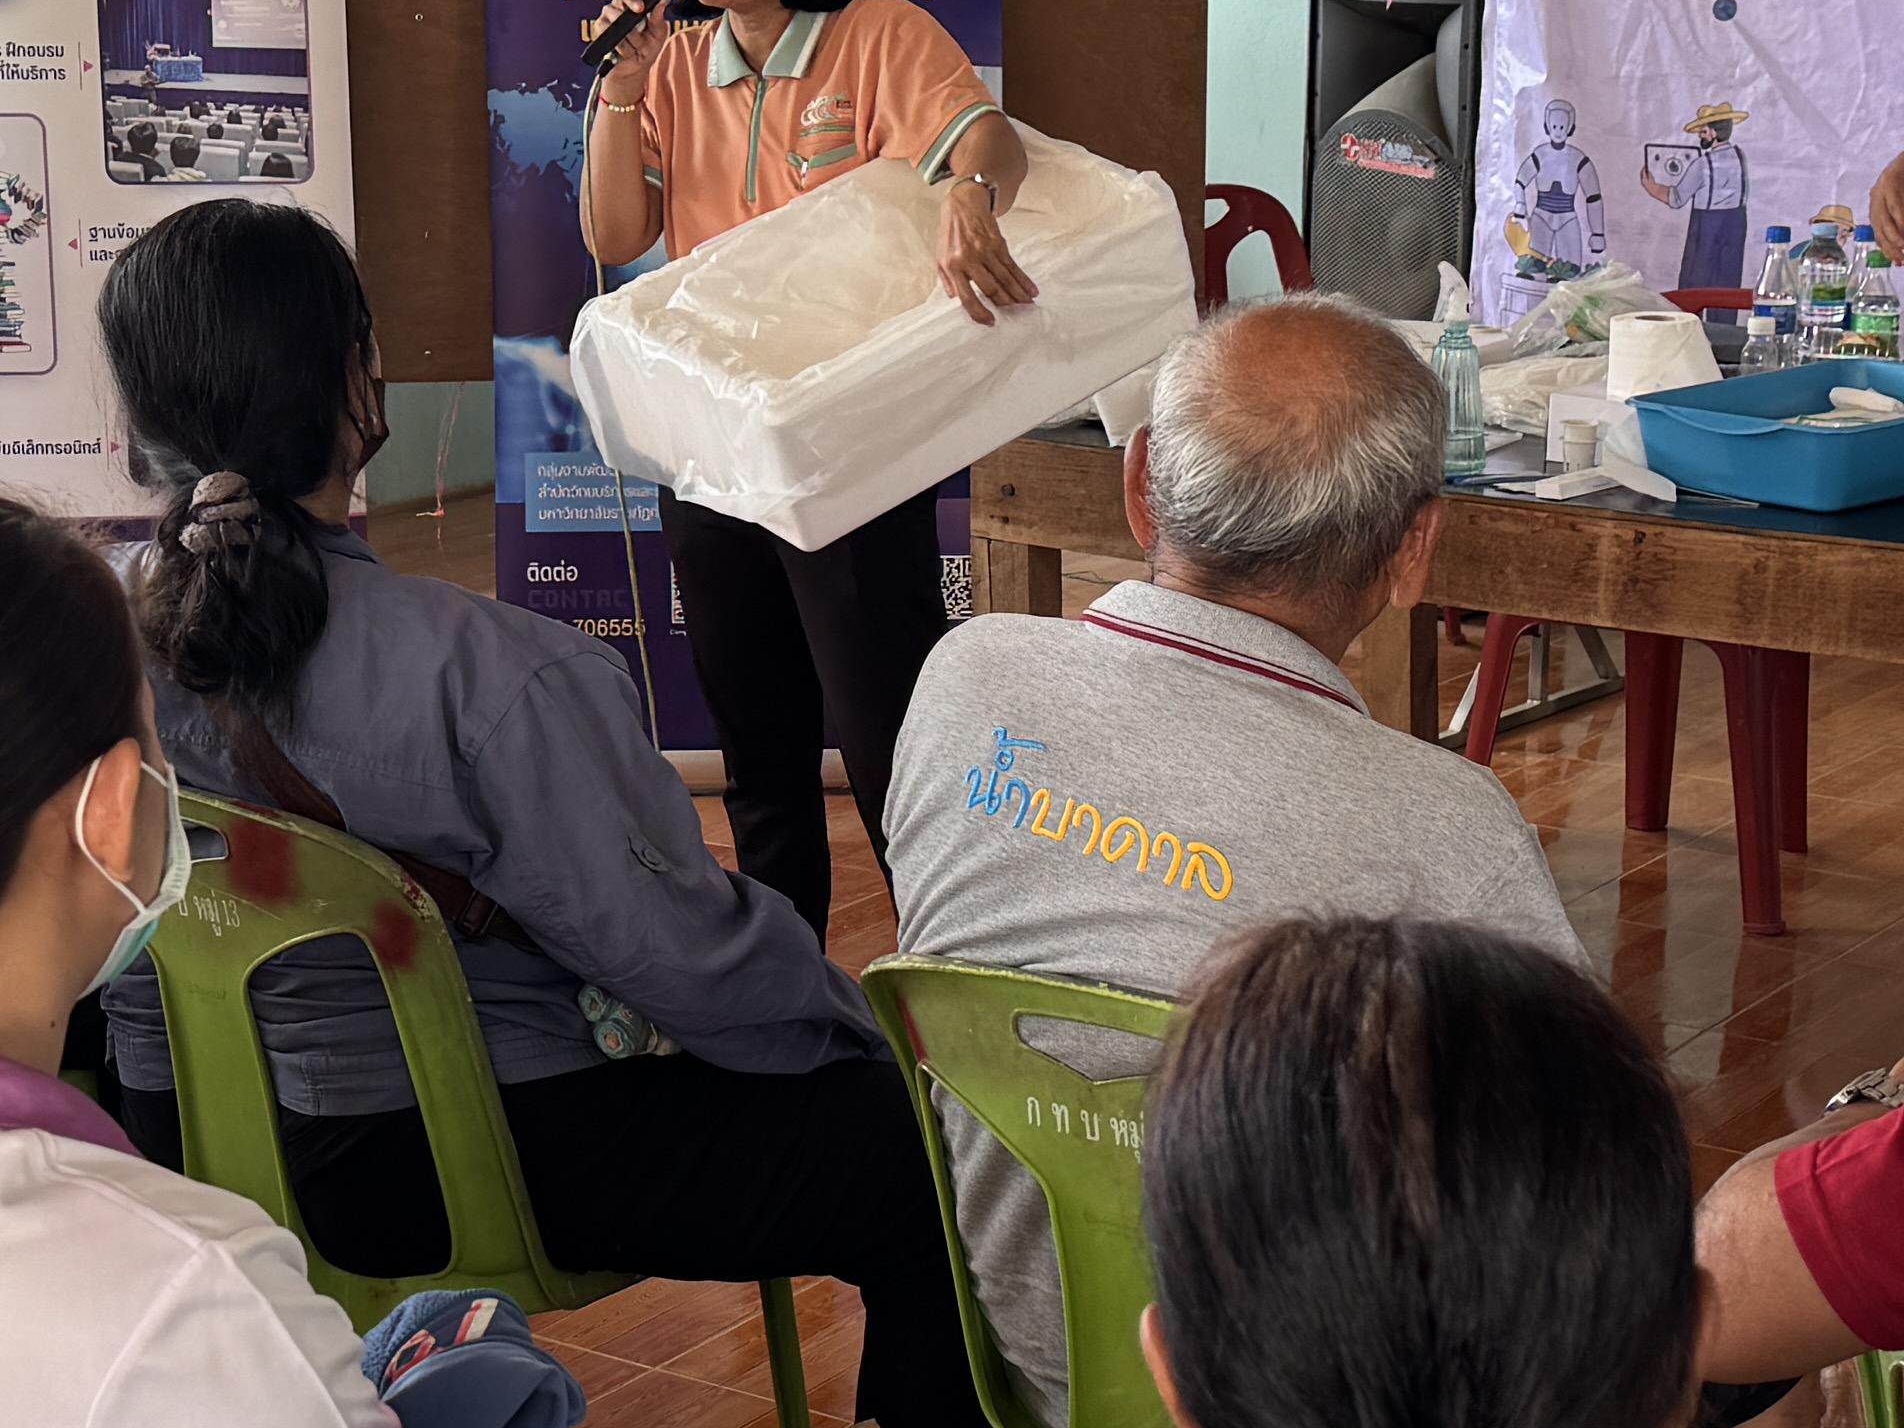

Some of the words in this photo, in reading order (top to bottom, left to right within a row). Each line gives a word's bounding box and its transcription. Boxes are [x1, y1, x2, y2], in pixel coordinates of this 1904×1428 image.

[527, 559, 579, 582] ติดต่อ
[963, 725, 1234, 901] น้ำบาดาล
[222, 898, 240, 928] 13
[1026, 1096, 1041, 1128] ก
[1051, 1102, 1070, 1134] ท
[1080, 1109, 1100, 1142] บ
